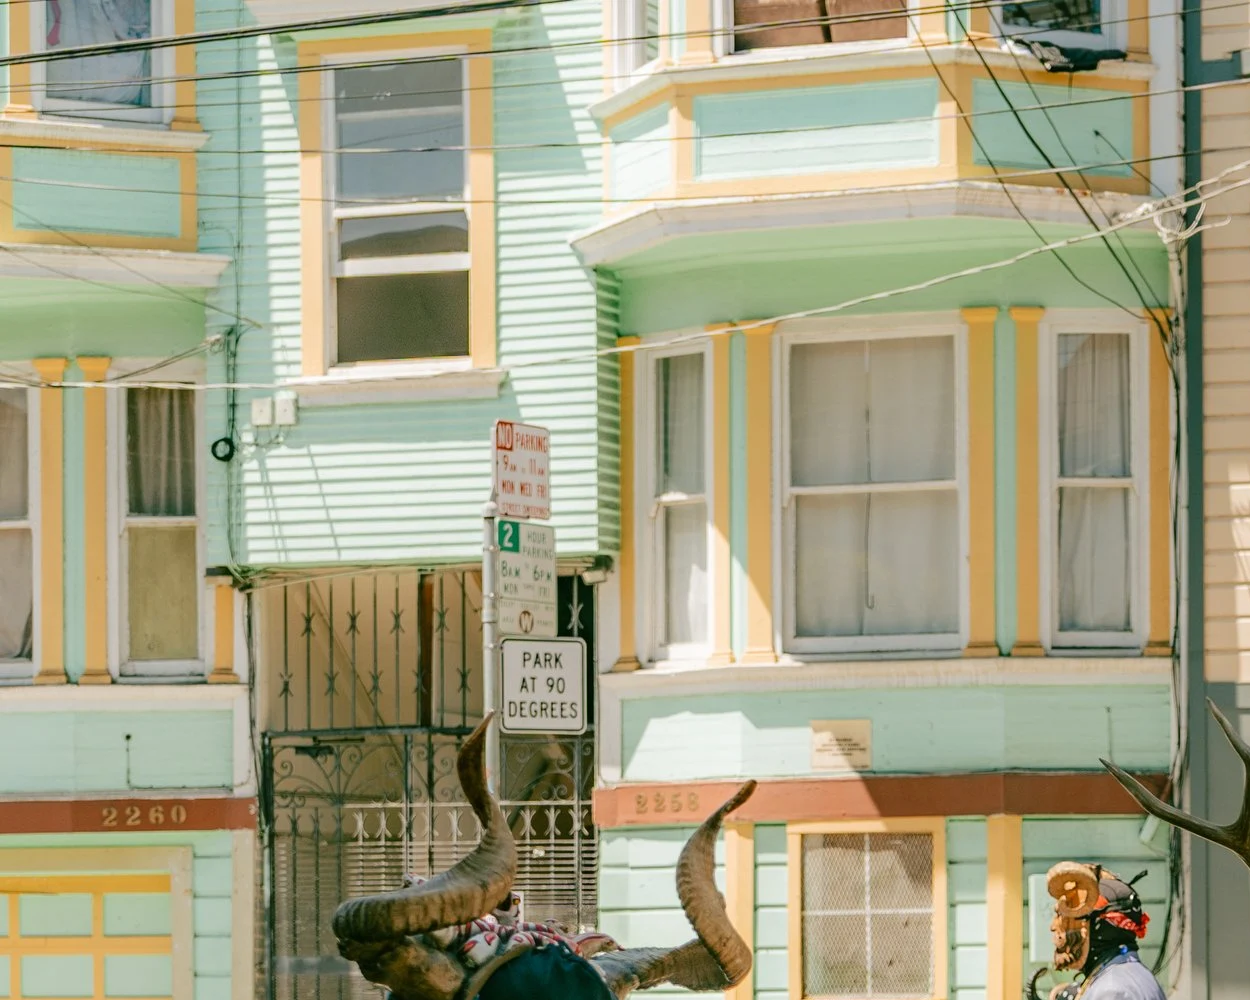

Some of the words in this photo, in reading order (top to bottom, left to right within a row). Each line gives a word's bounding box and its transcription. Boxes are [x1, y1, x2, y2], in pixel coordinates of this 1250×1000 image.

[498, 423, 511, 447] NO
[516, 432, 547, 453] PARKING
[502, 480, 515, 494] MON
[520, 483, 532, 497] WED
[537, 484, 547, 499] FRI
[503, 523, 514, 548] 2
[527, 531, 546, 544] HOUR
[522, 546, 553, 561] PARKING
[504, 583, 519, 595] MON
[523, 652, 562, 669] PARK
[520, 677, 536, 693] AT
[546, 677, 565, 694] 90
[509, 701, 578, 719] DEGREES
[102, 805, 187, 827] 2260
